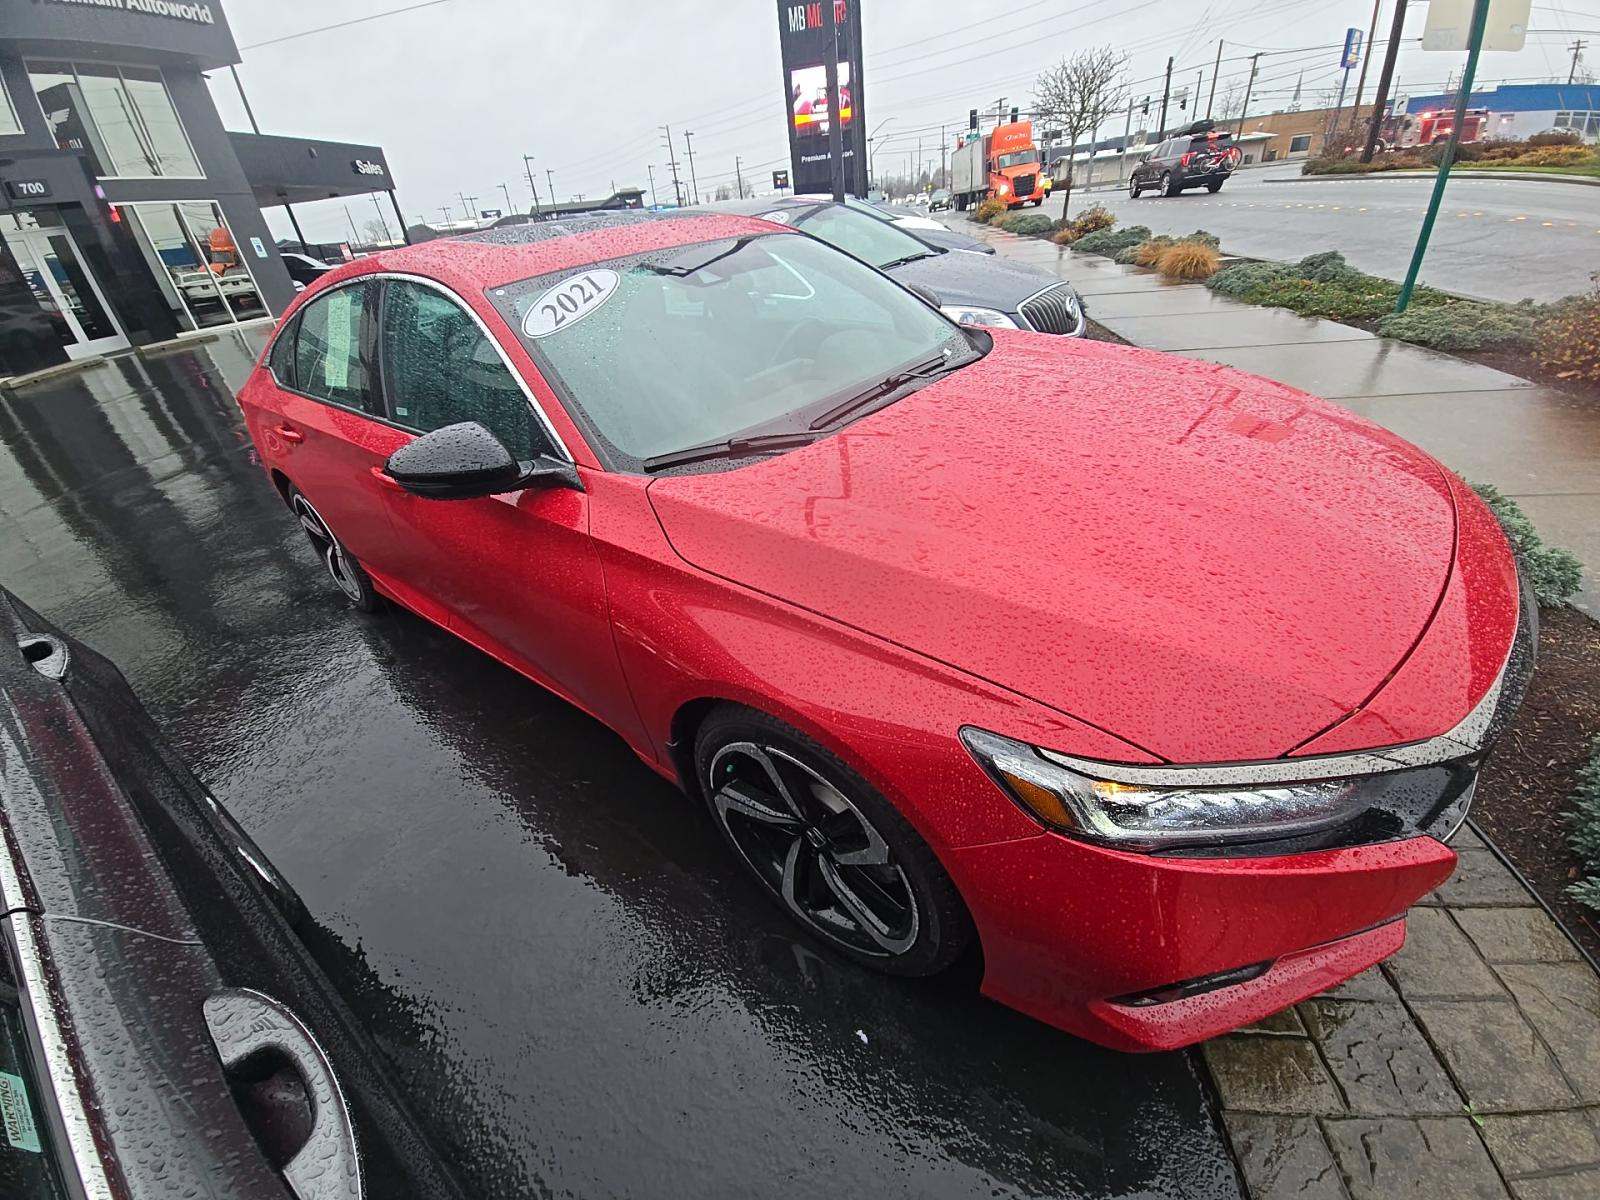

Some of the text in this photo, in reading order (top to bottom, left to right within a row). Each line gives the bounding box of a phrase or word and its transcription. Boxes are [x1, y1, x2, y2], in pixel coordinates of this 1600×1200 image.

[126, 0, 214, 24] Autoworld
[788, 6, 805, 32] MB
[355, 159, 384, 175] Sales
[18, 182, 45, 194] 700
[541, 275, 606, 327] 2021
[0, 1080, 21, 1141] WARNING
